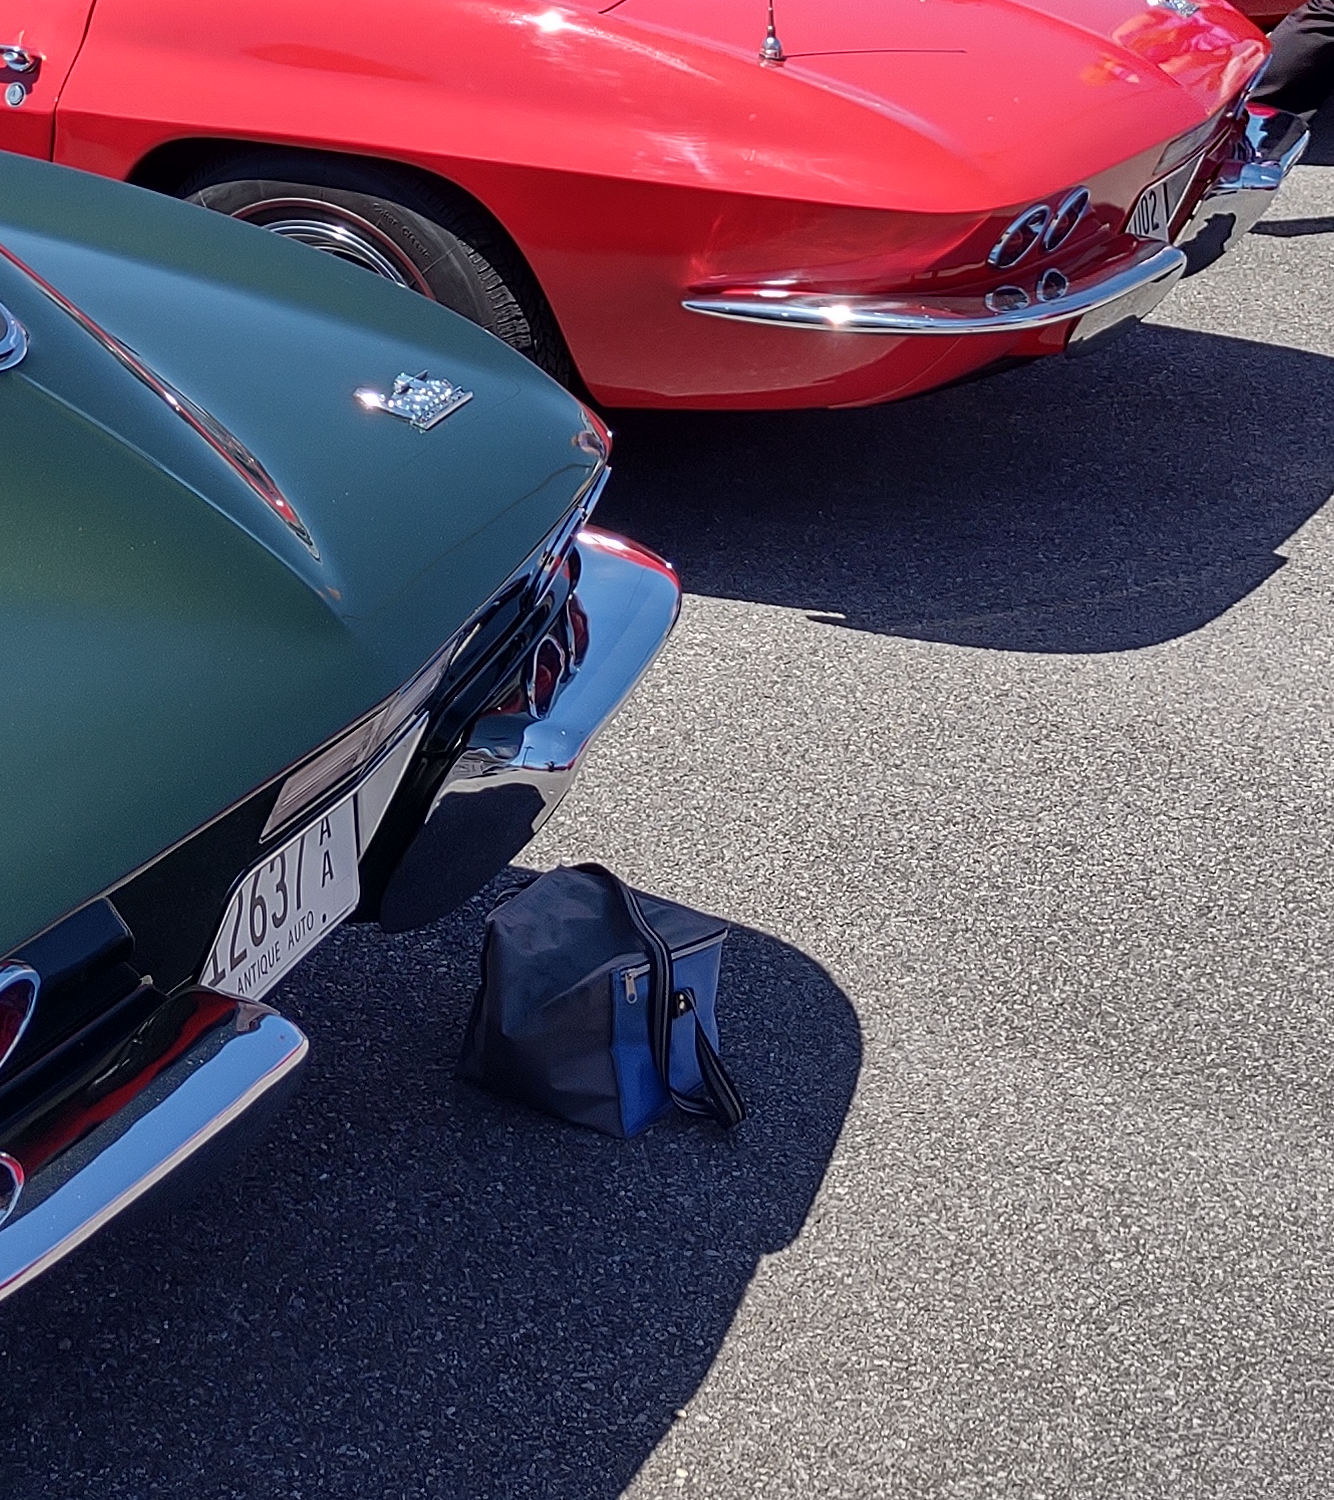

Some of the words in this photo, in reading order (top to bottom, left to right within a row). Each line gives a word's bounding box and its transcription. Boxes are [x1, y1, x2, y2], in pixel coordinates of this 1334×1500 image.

[372, 202, 398, 226] Coker
[401, 225, 431, 259] Classic
[237, 940, 282, 995] ANTIQUE
[287, 910, 315, 950] AUTO
